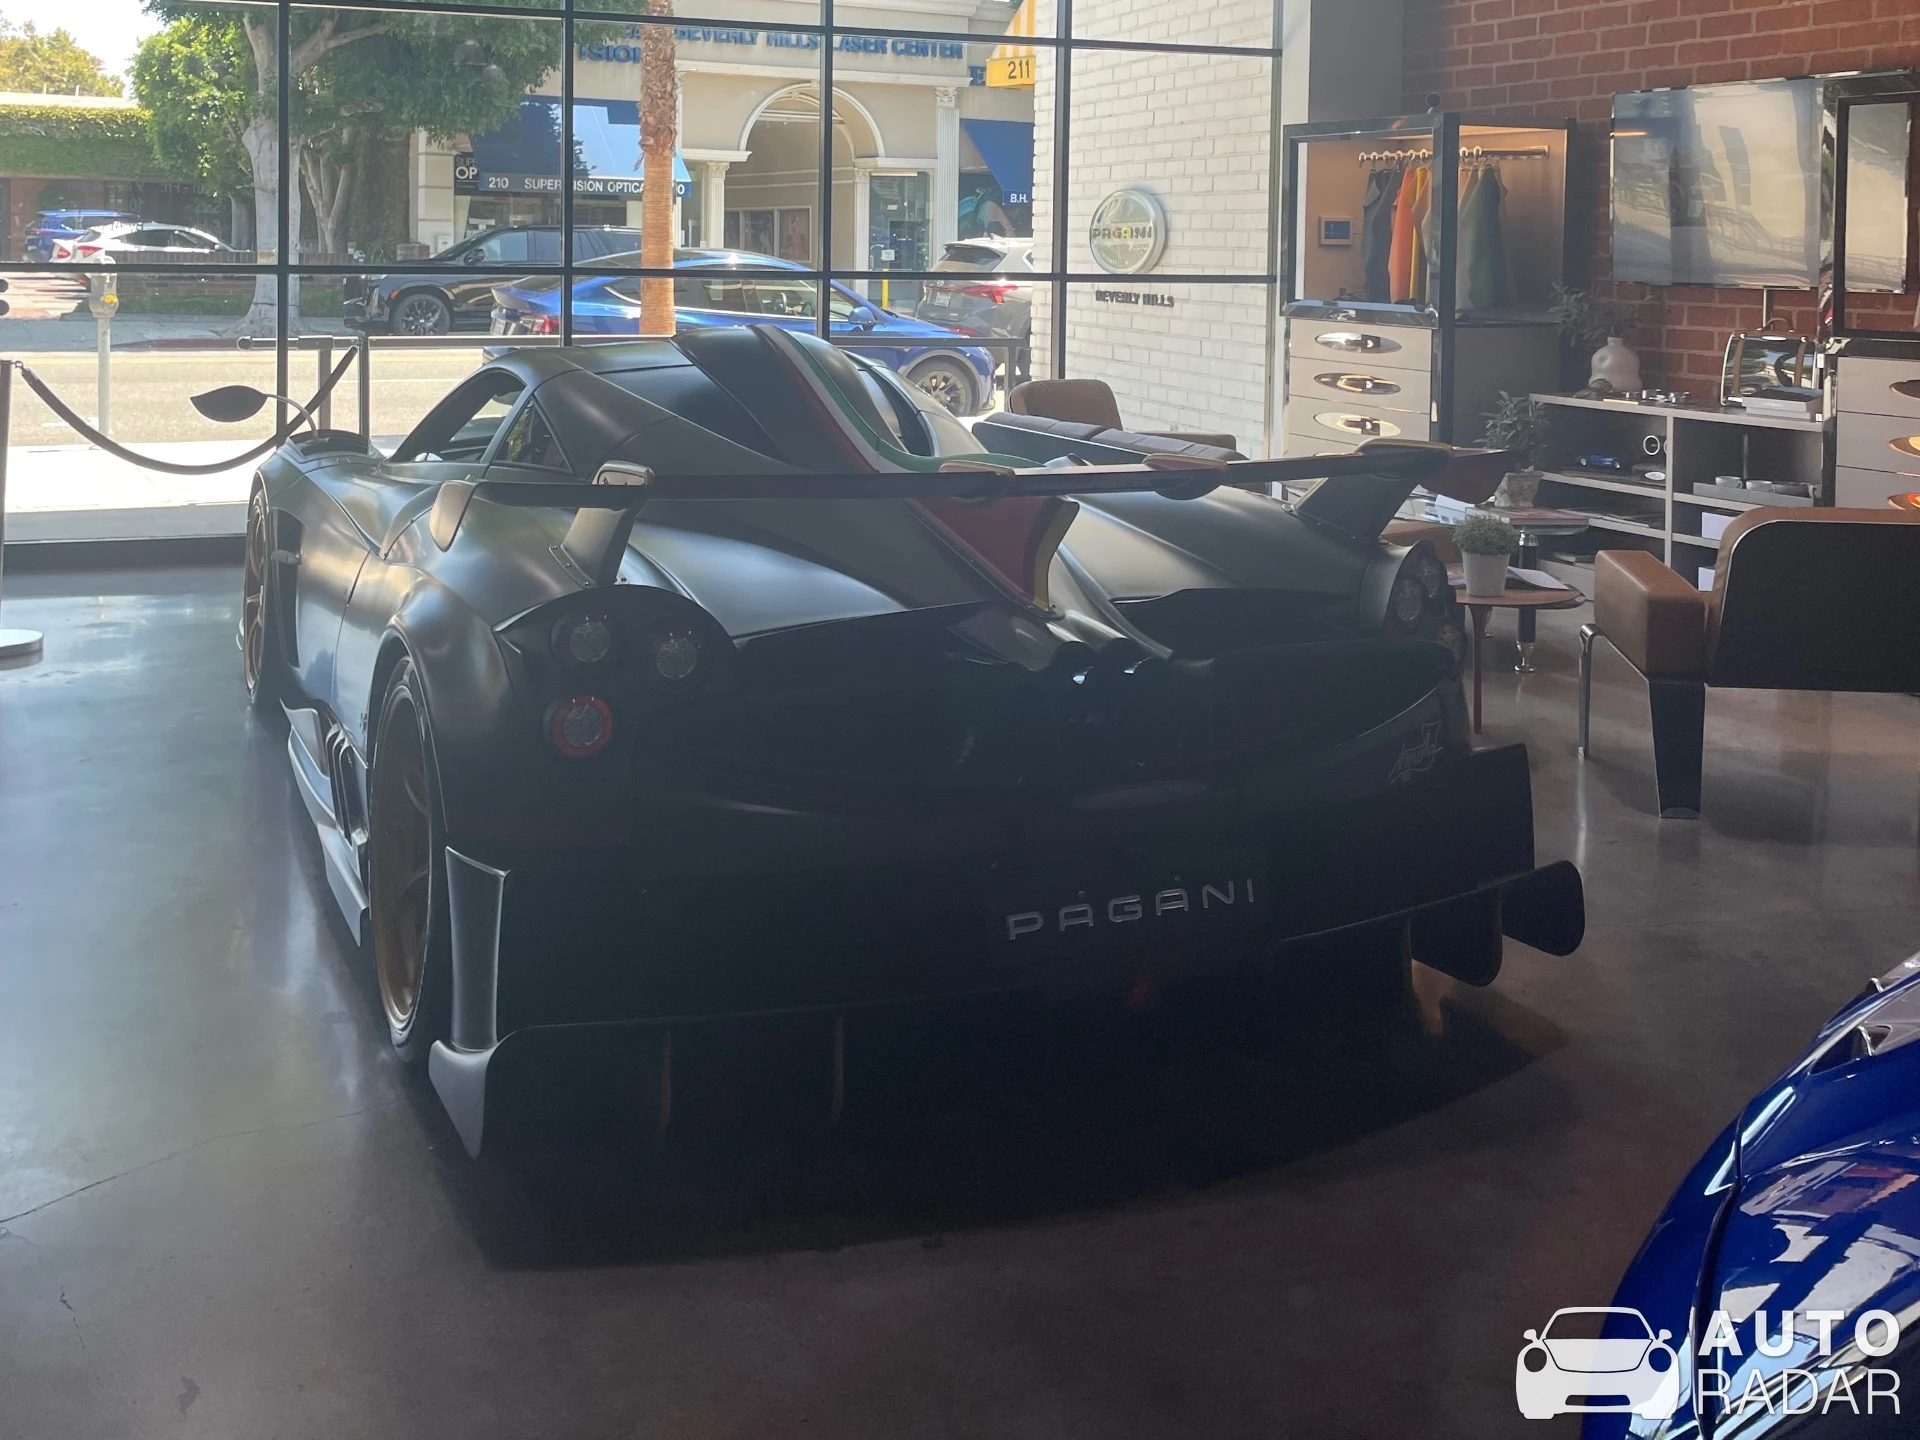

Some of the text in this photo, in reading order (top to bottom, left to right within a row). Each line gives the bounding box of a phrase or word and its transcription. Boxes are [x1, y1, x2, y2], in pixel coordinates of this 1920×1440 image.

[891, 39, 964, 59] CENTER
[1007, 59, 1031, 80] 211
[488, 177, 509, 189] 210
[1010, 193, 1028, 204] B.H.
[1092, 226, 1152, 240] PAGANI
[1095, 290, 1175, 308] BEVERLY HILLS
[1006, 878, 1255, 940] PAGANI
